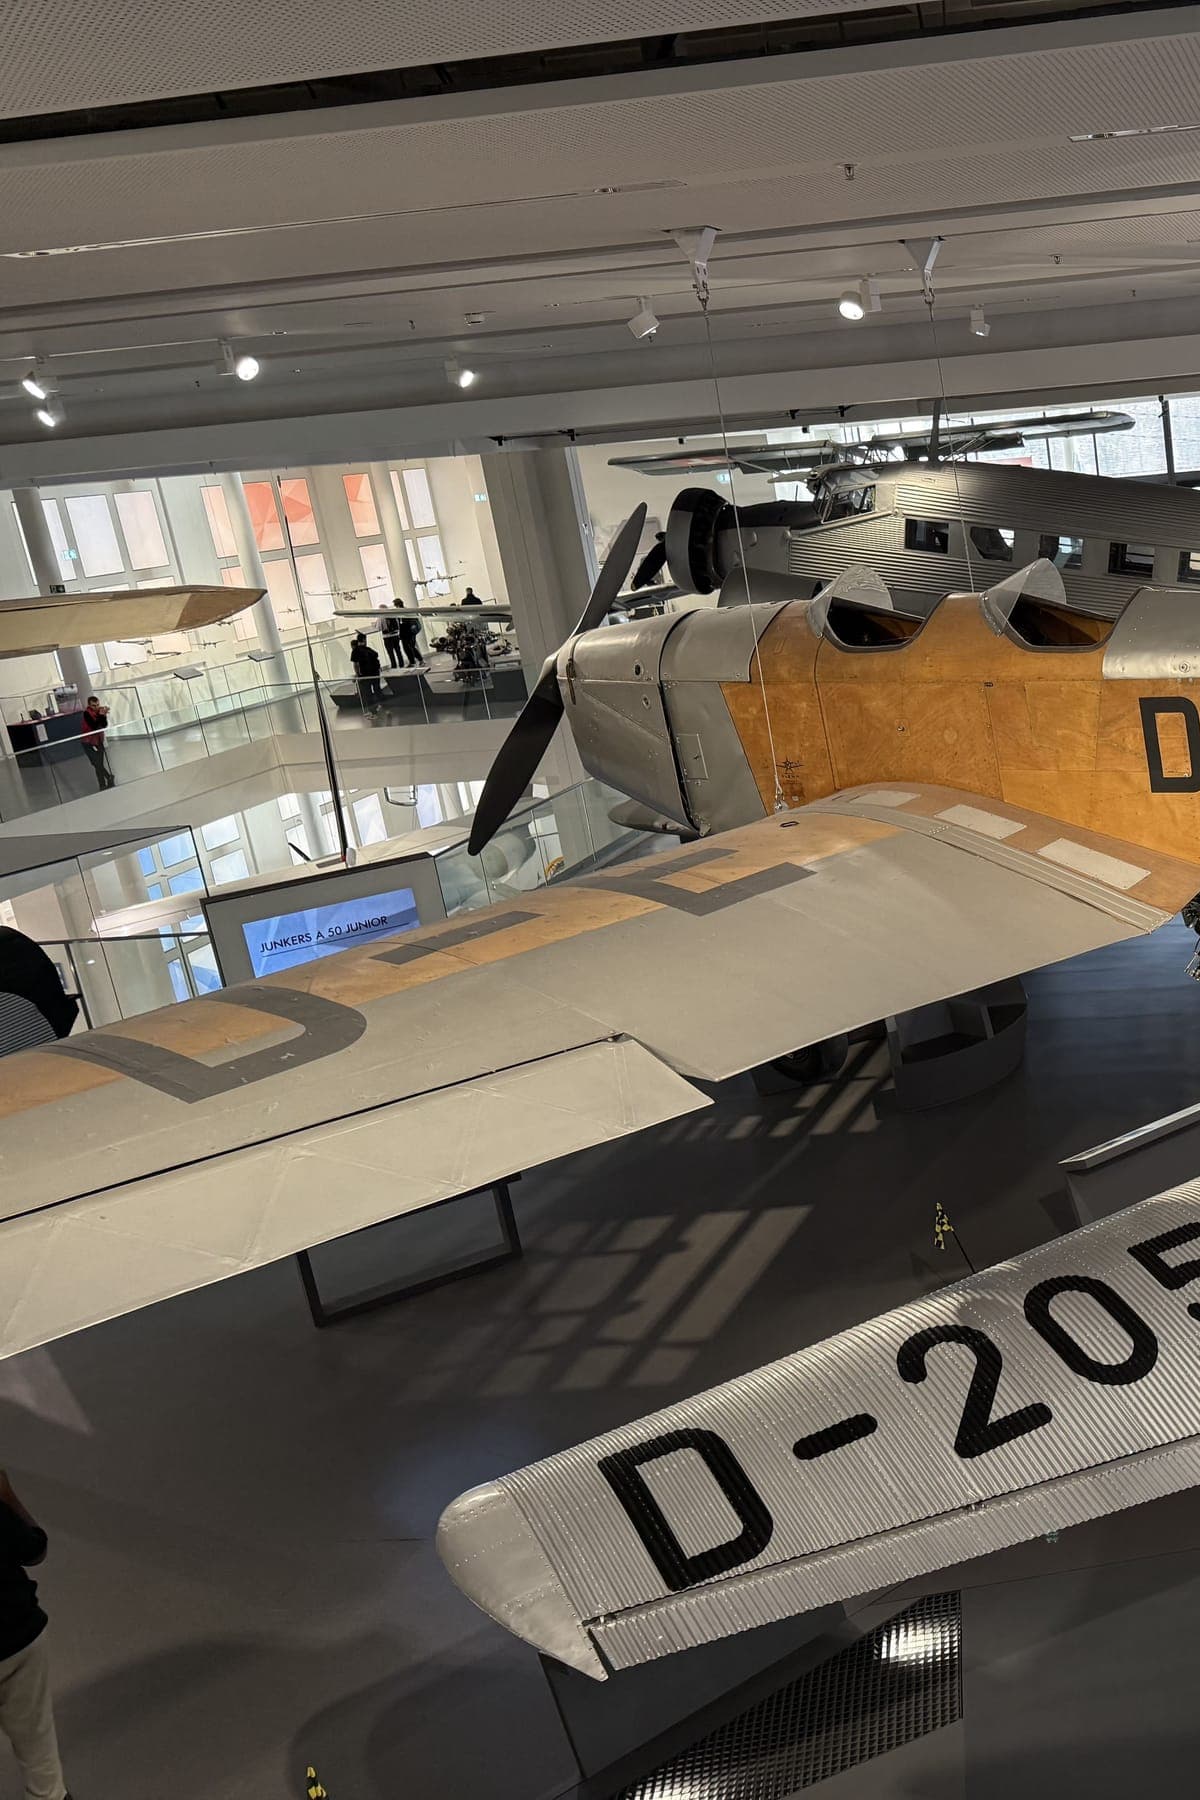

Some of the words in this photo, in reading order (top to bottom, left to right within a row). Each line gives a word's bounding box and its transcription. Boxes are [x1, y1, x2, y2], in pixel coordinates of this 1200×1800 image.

[260, 932, 313, 953] JUNKERS
[316, 930, 325, 940] A
[328, 926, 343, 938] 50
[345, 915, 389, 934] JUNIOR
